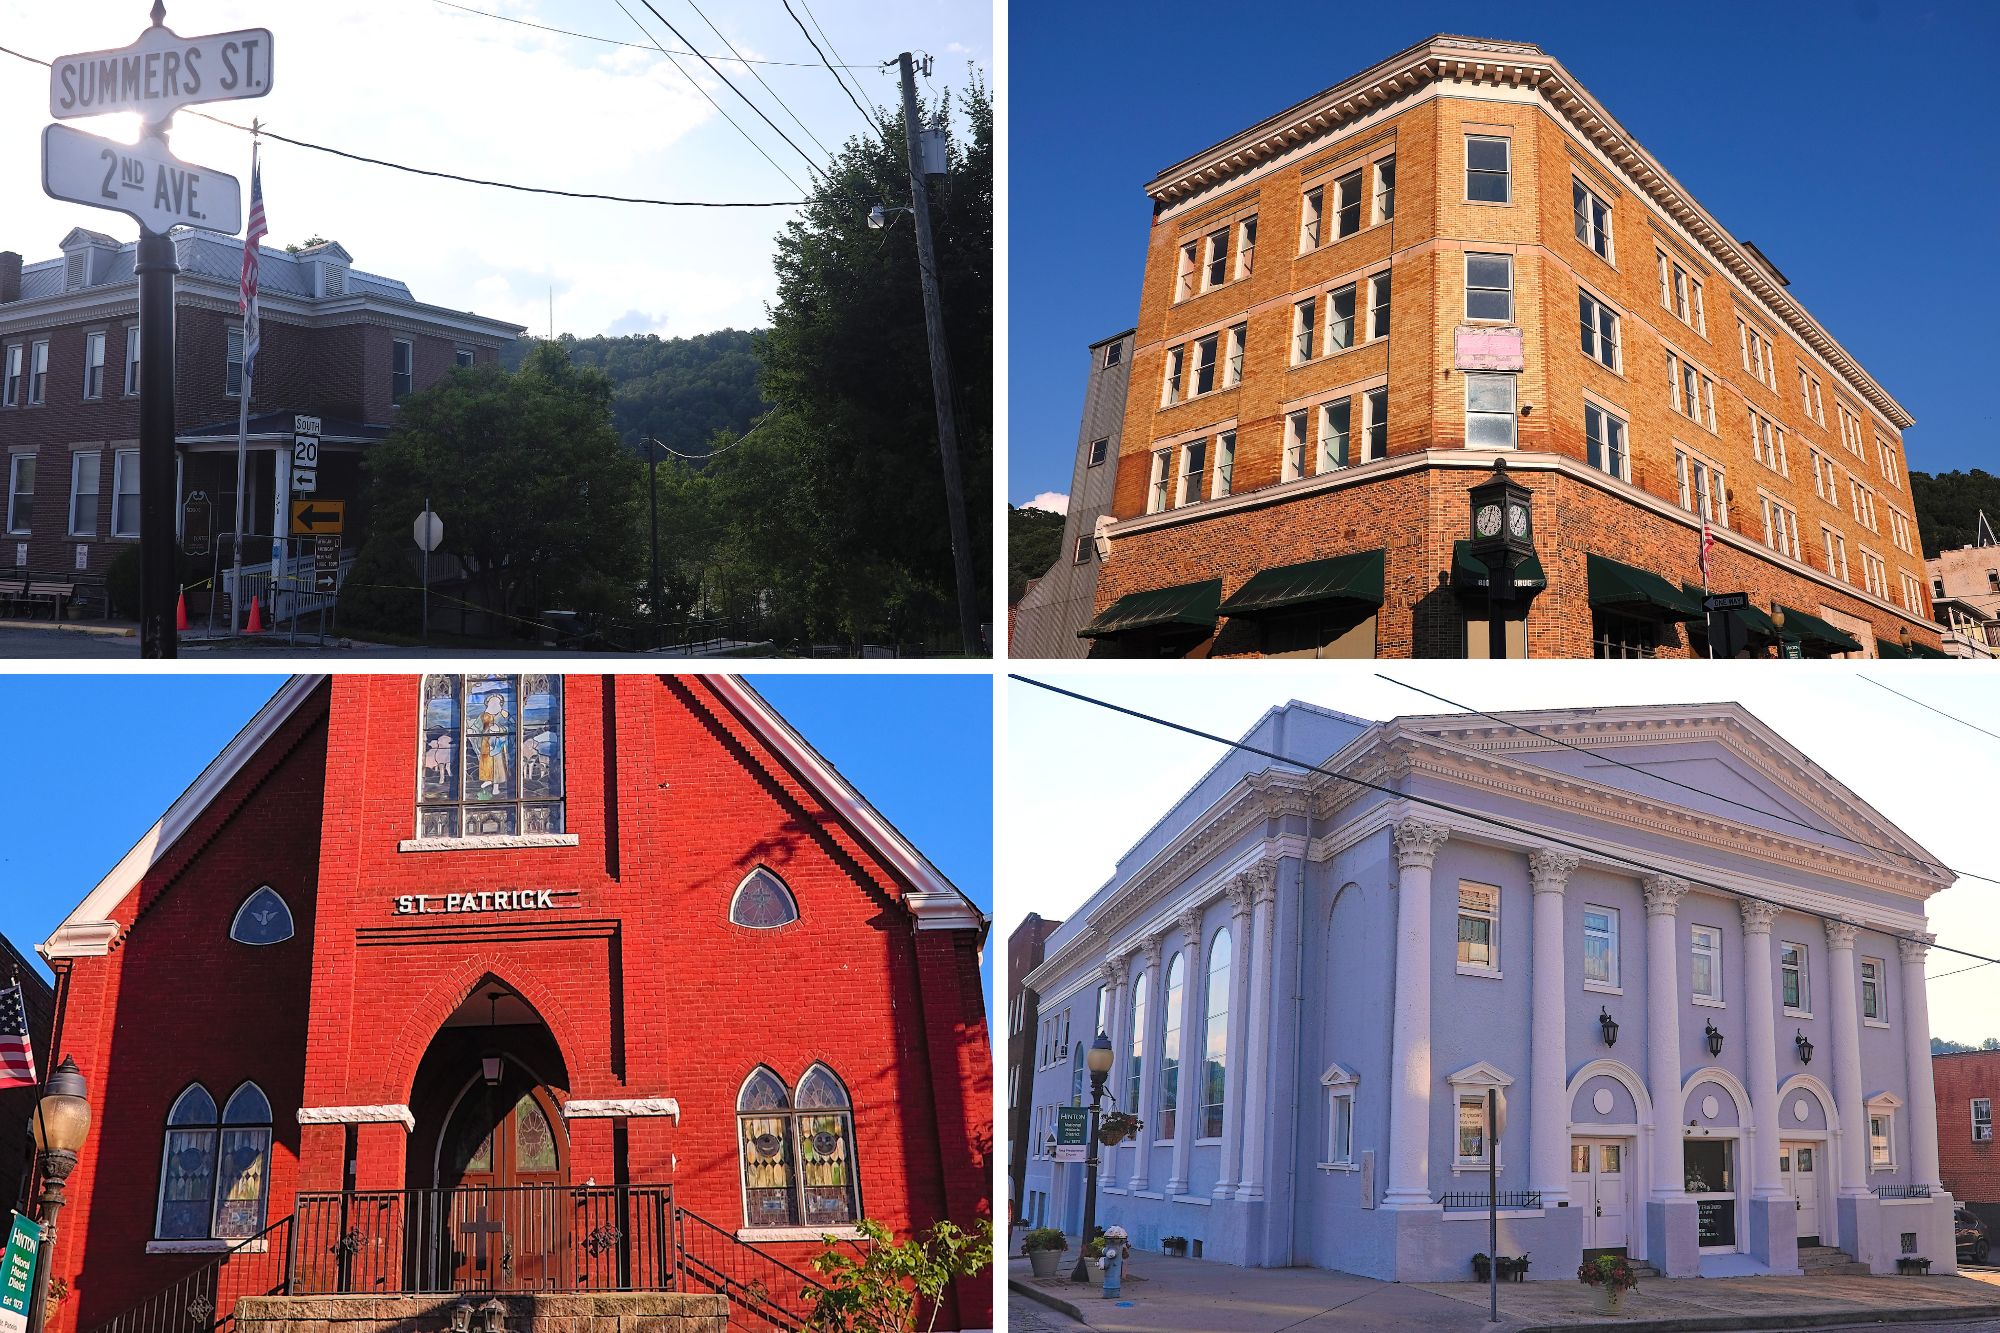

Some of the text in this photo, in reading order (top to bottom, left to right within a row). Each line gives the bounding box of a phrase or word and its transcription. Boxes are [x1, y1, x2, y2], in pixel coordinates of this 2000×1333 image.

[59, 39, 262, 109] SUMMERS ST.
[100, 148, 207, 220] 2ND AVE.
[296, 418, 320, 432] SOUTH
[295, 441, 317, 461] 20
[1714, 597, 1742, 608] ONE WAY
[399, 889, 554, 913] ST. PATRICK
[11, 1227, 37, 1255] HINTON
[12, 1253, 31, 1270] National
[10, 1265, 28, 1281] Historic
[8, 1276, 26, 1293] District
